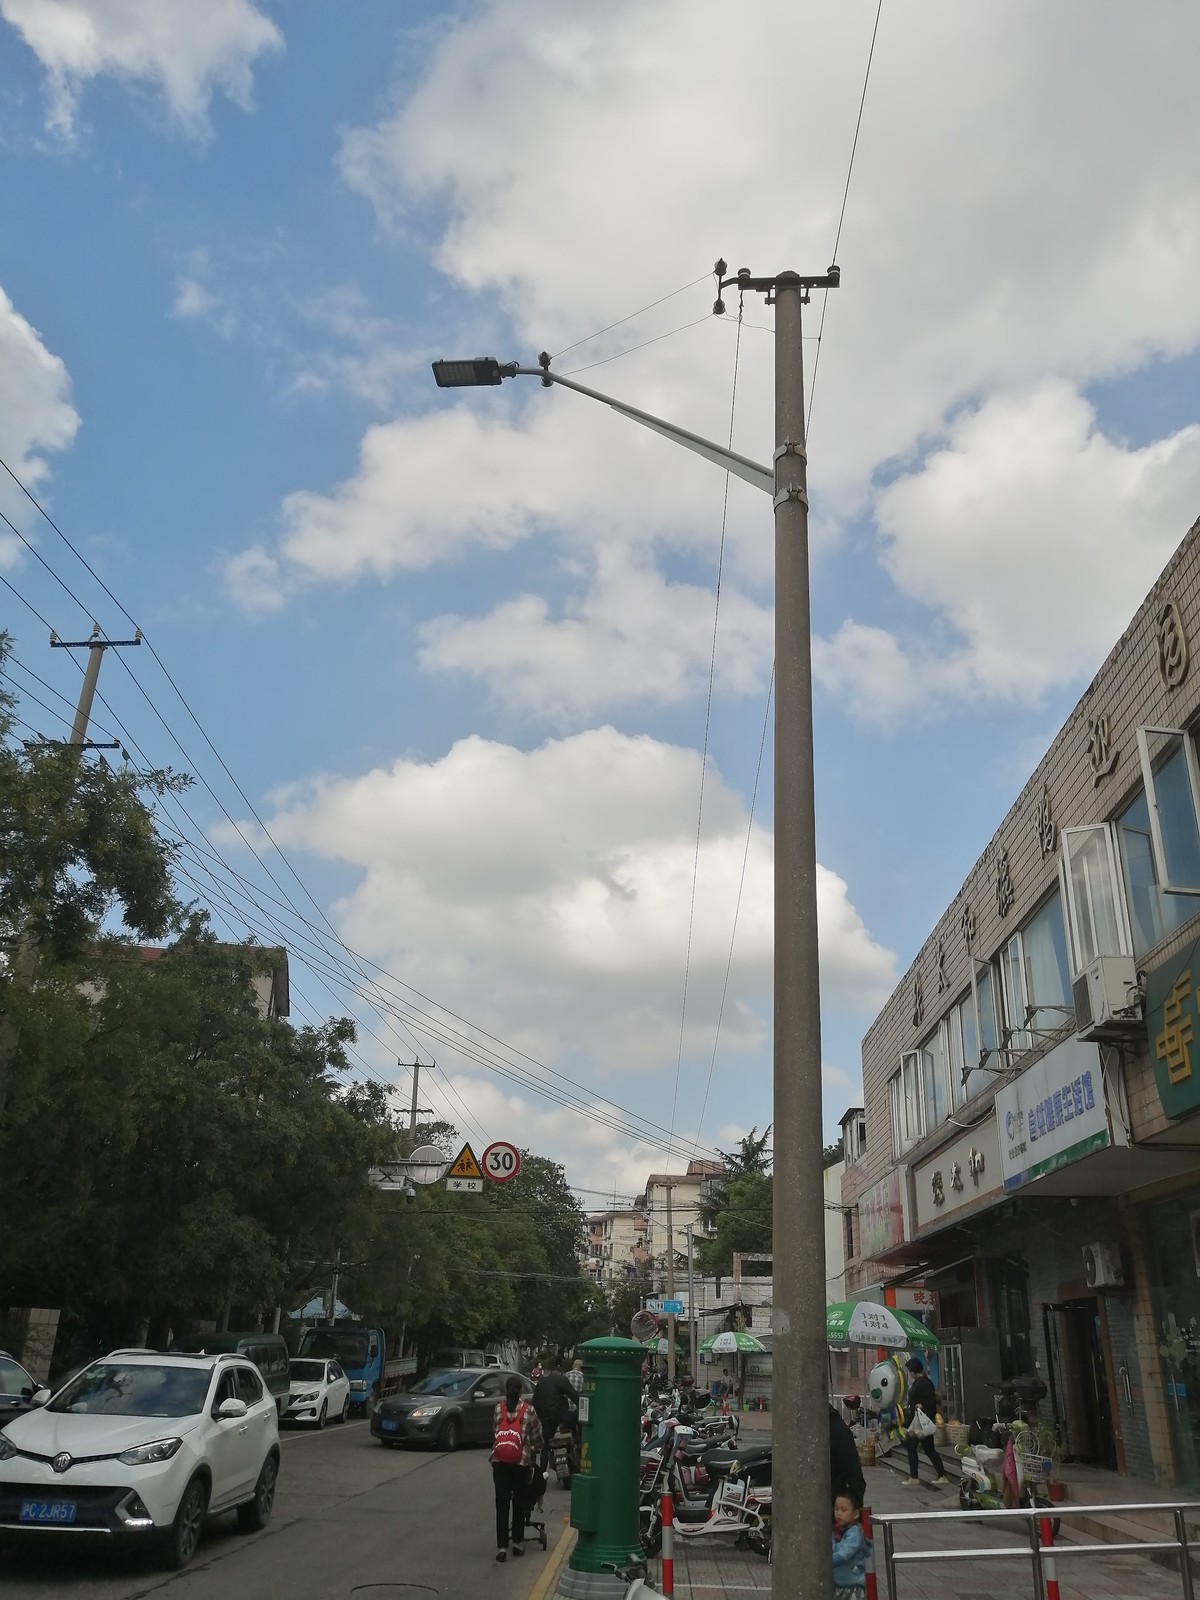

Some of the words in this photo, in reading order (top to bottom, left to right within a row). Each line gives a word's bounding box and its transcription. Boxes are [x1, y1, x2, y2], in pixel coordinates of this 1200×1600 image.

[1027, 1070, 1095, 1142] 自然健康生活馆
[489, 1152, 514, 1171] 30
[452, 1180, 477, 1190] 学校
[861, 1312, 886, 1321] 1对1
[862, 1320, 890, 1330] 1对4
